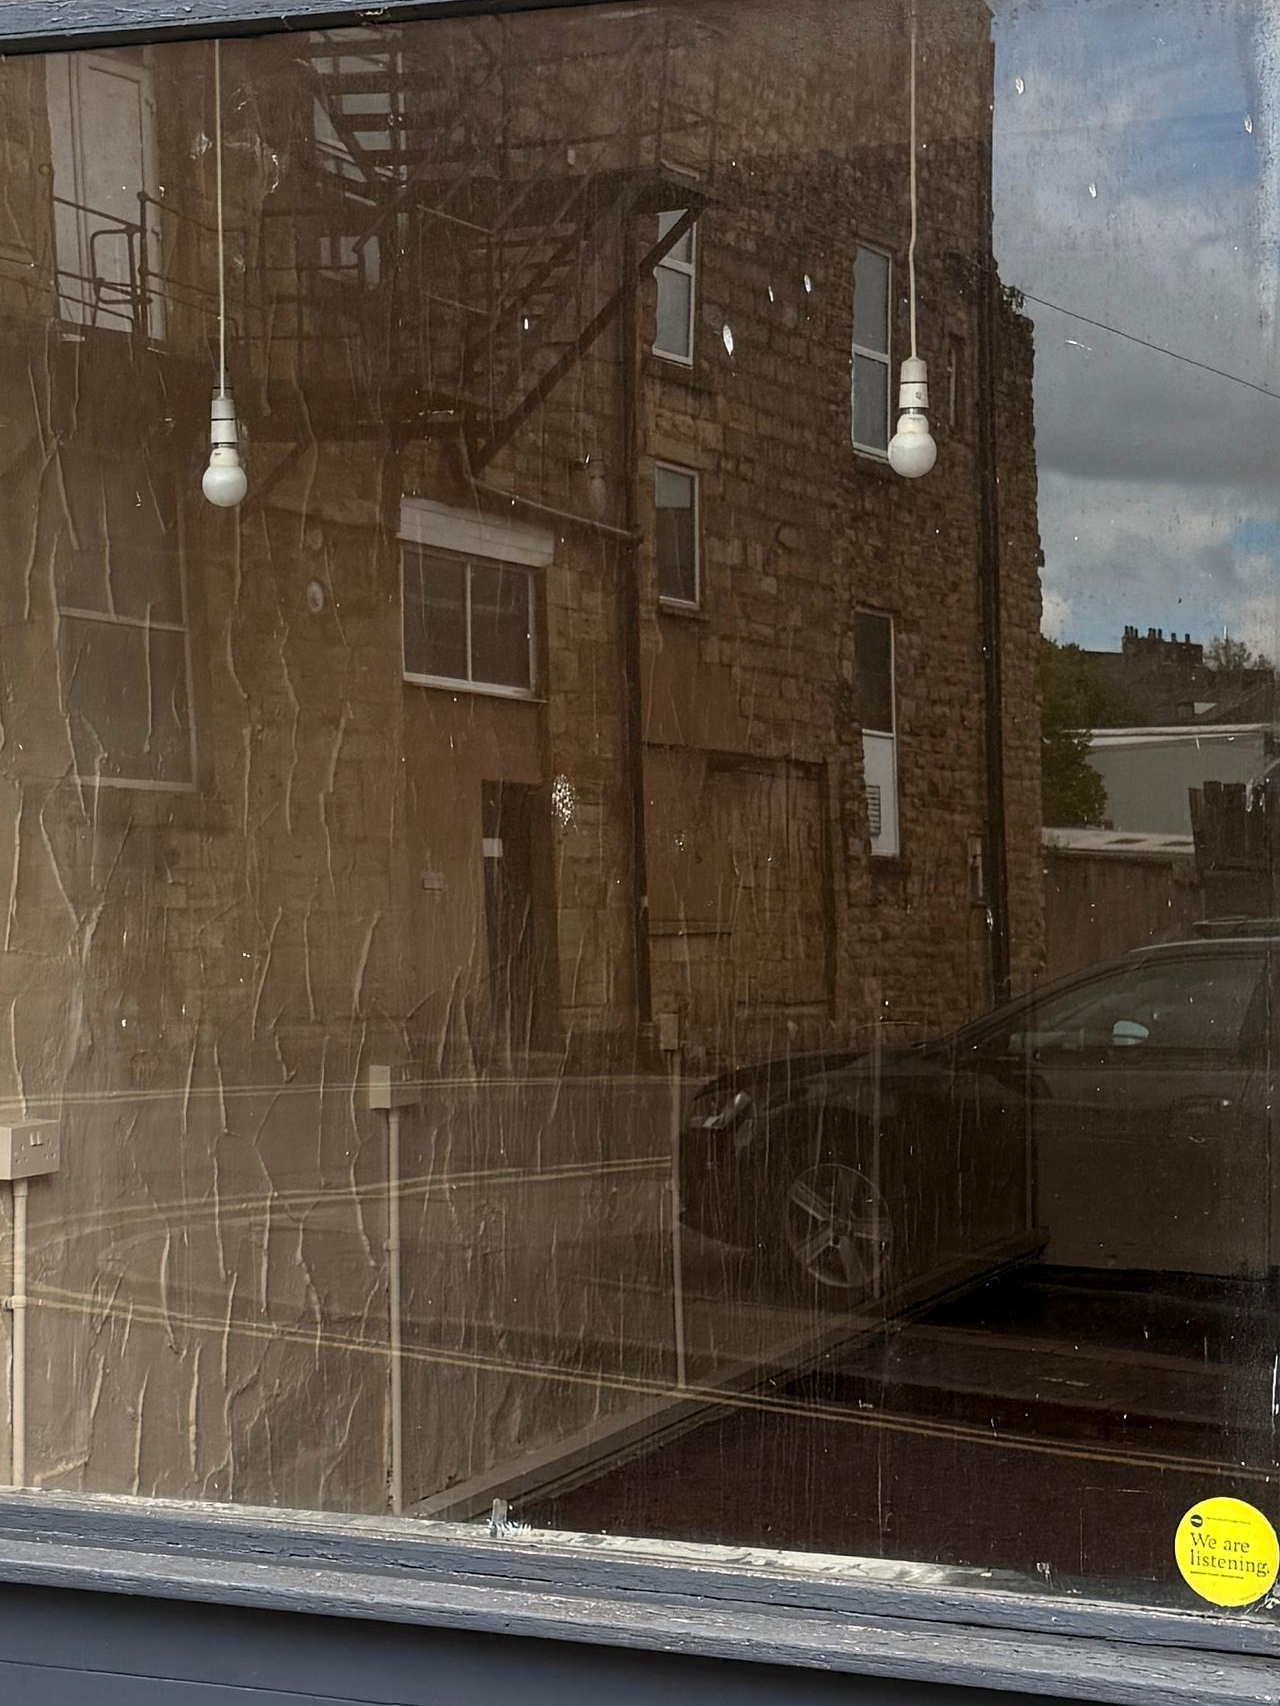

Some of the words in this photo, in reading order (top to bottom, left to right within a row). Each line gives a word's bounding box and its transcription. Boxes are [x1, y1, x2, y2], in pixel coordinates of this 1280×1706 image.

[1190, 1532, 1217, 1550] We
[1223, 1540, 1250, 1553] are
[1190, 1549, 1270, 1578] listening.
